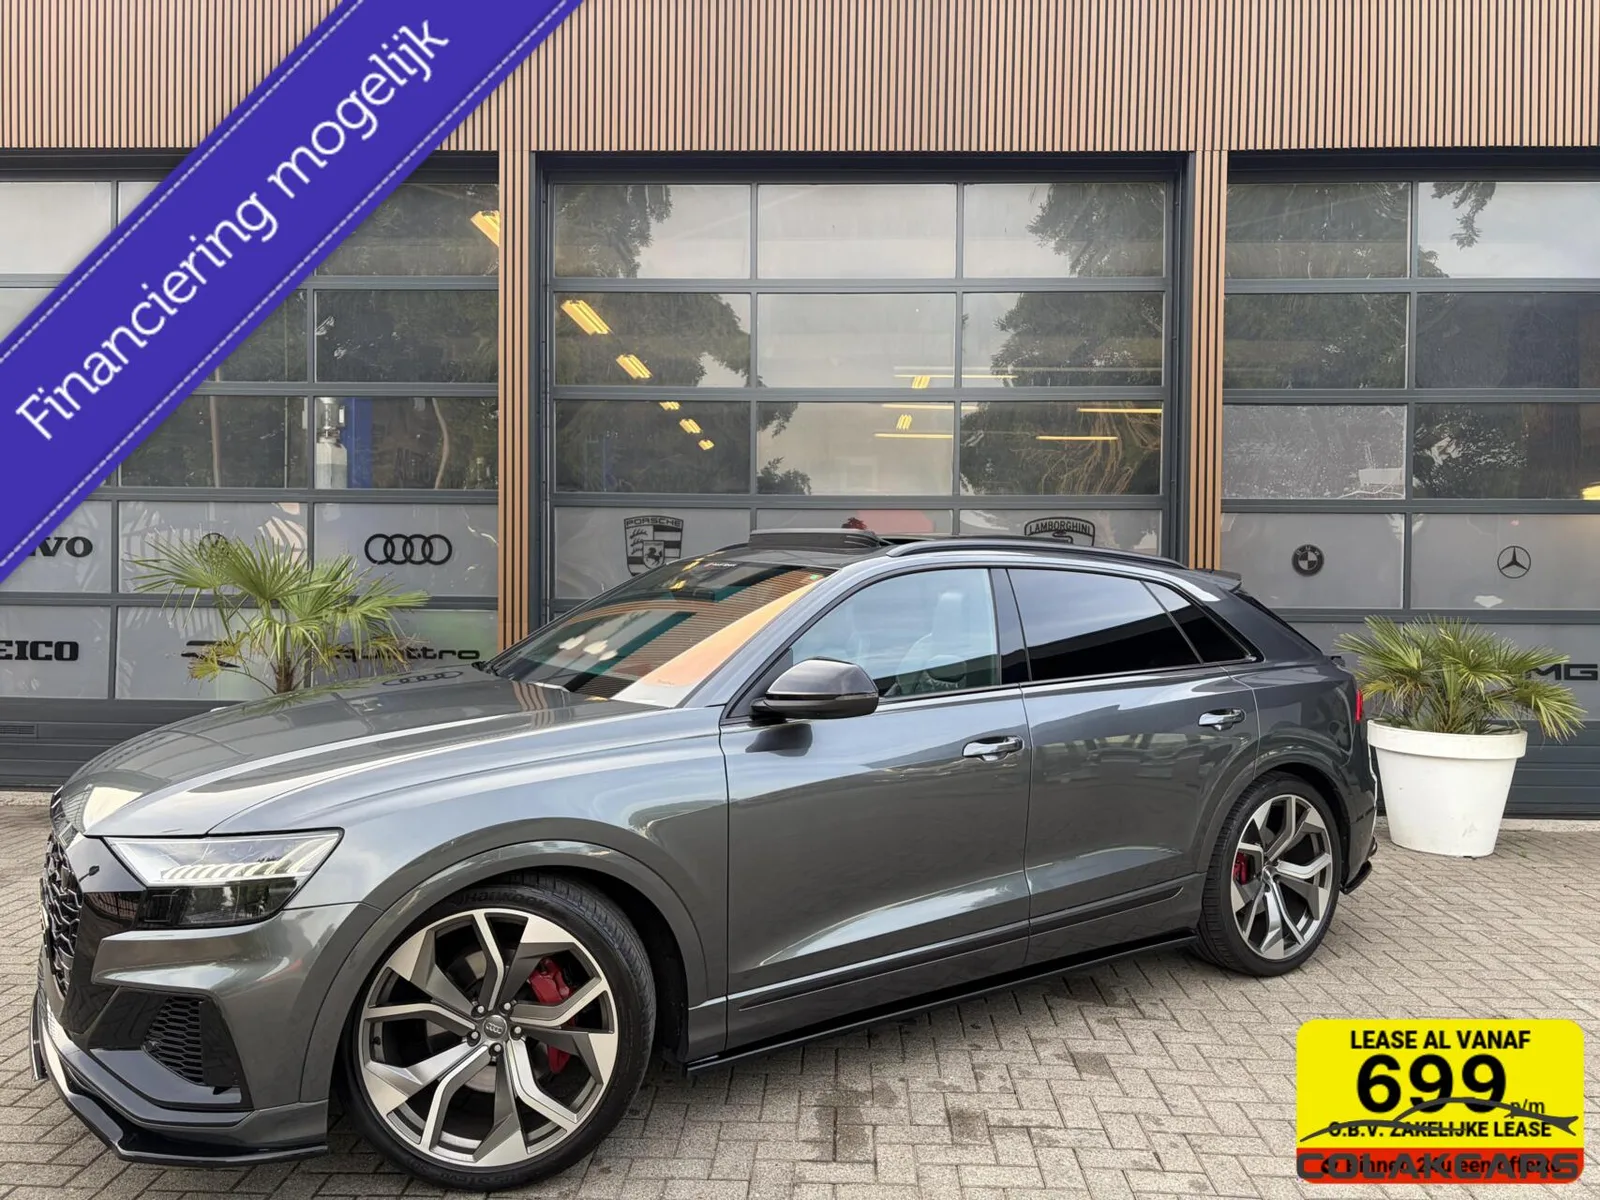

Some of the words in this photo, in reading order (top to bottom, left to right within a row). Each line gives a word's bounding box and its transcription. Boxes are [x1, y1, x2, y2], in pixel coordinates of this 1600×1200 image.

[626, 517, 682, 527] PORSCHE
[1029, 520, 1091, 534] LAMBORGHINI
[30, 536, 94, 558] VO
[335, 646, 481, 662] quttro
[1525, 663, 1599, 681] MG
